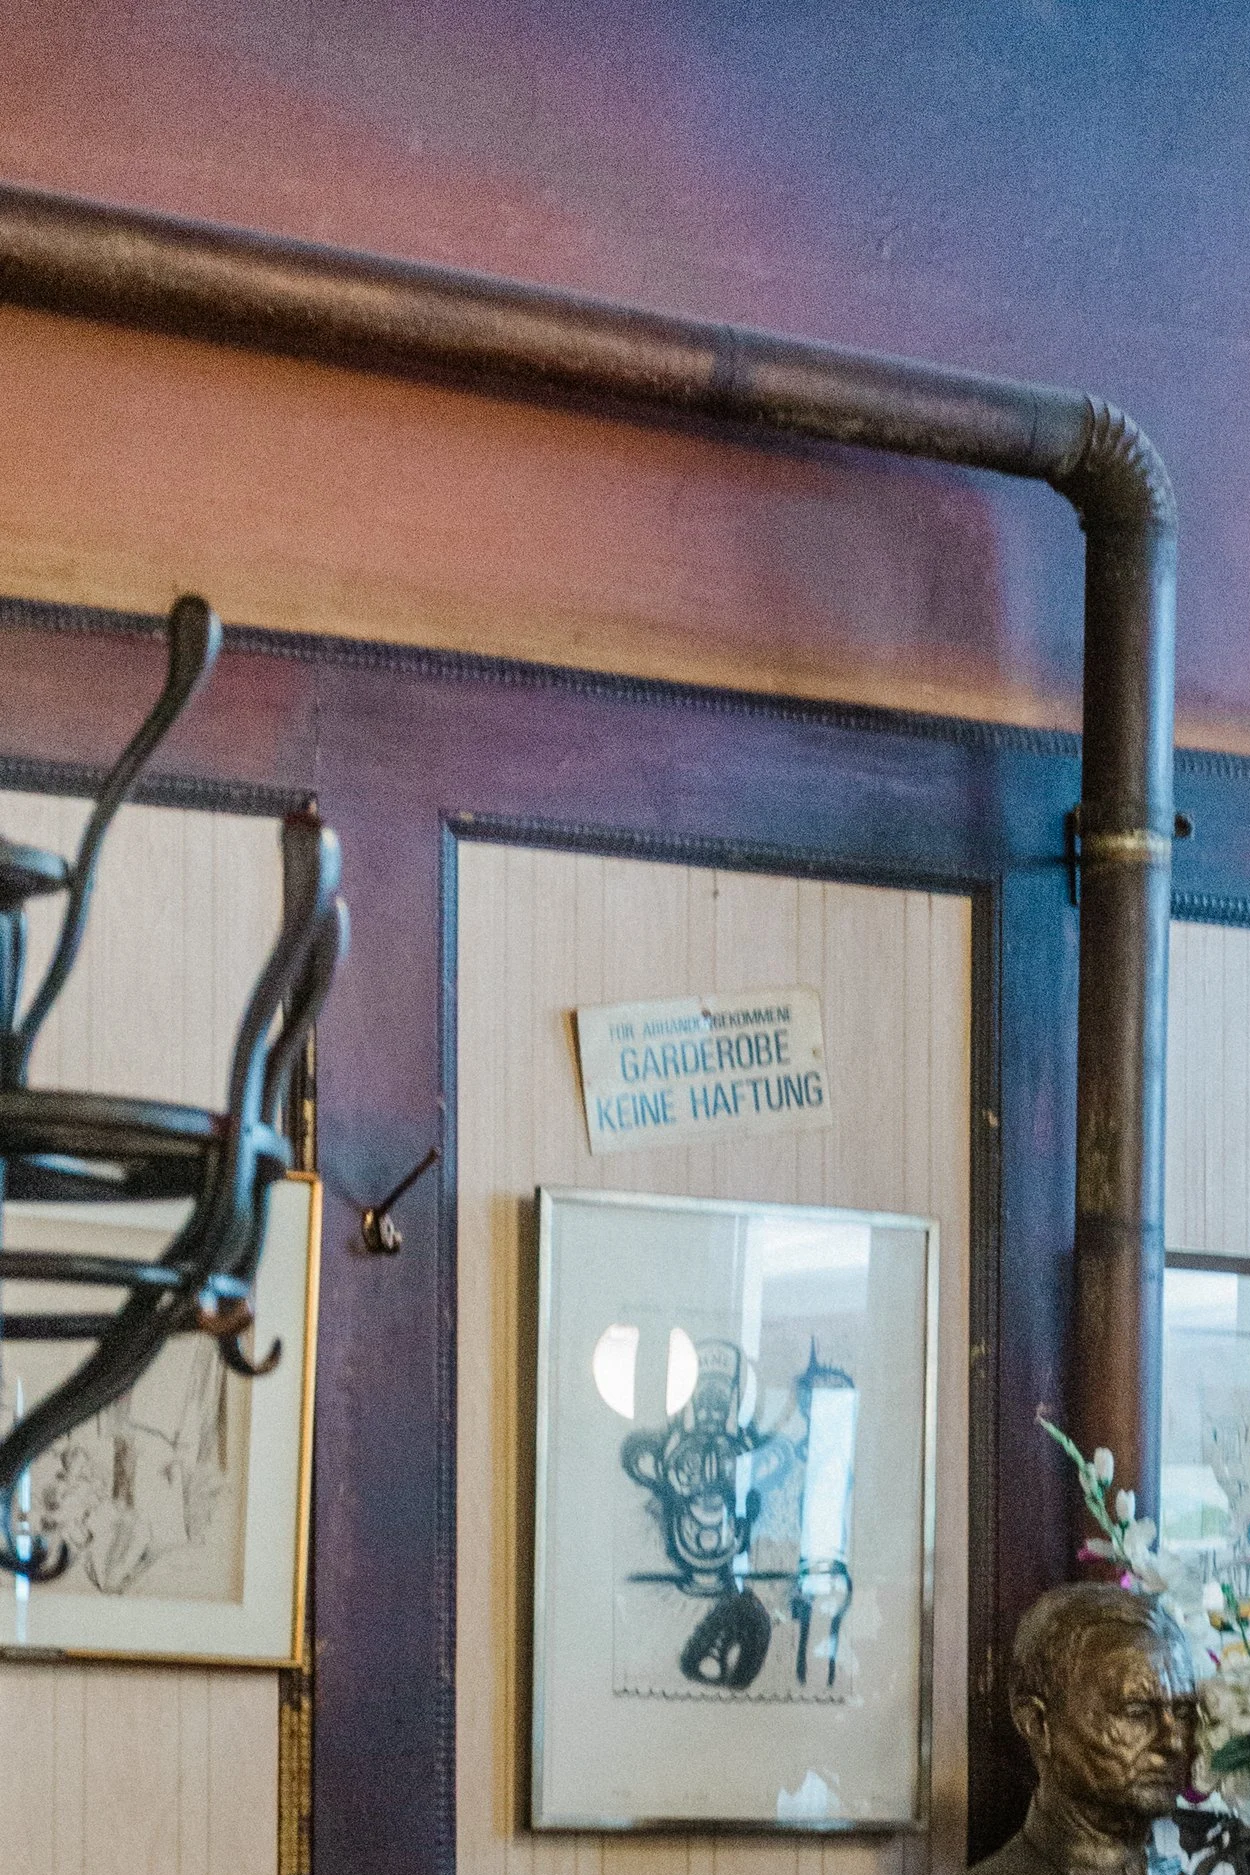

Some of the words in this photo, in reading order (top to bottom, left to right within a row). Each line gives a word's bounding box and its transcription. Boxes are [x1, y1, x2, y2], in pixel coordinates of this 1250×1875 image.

[620, 1029, 791, 1084] GARDEROBE
[596, 1088, 678, 1133] KEINE
[689, 1070, 824, 1121] HAFTUNG
